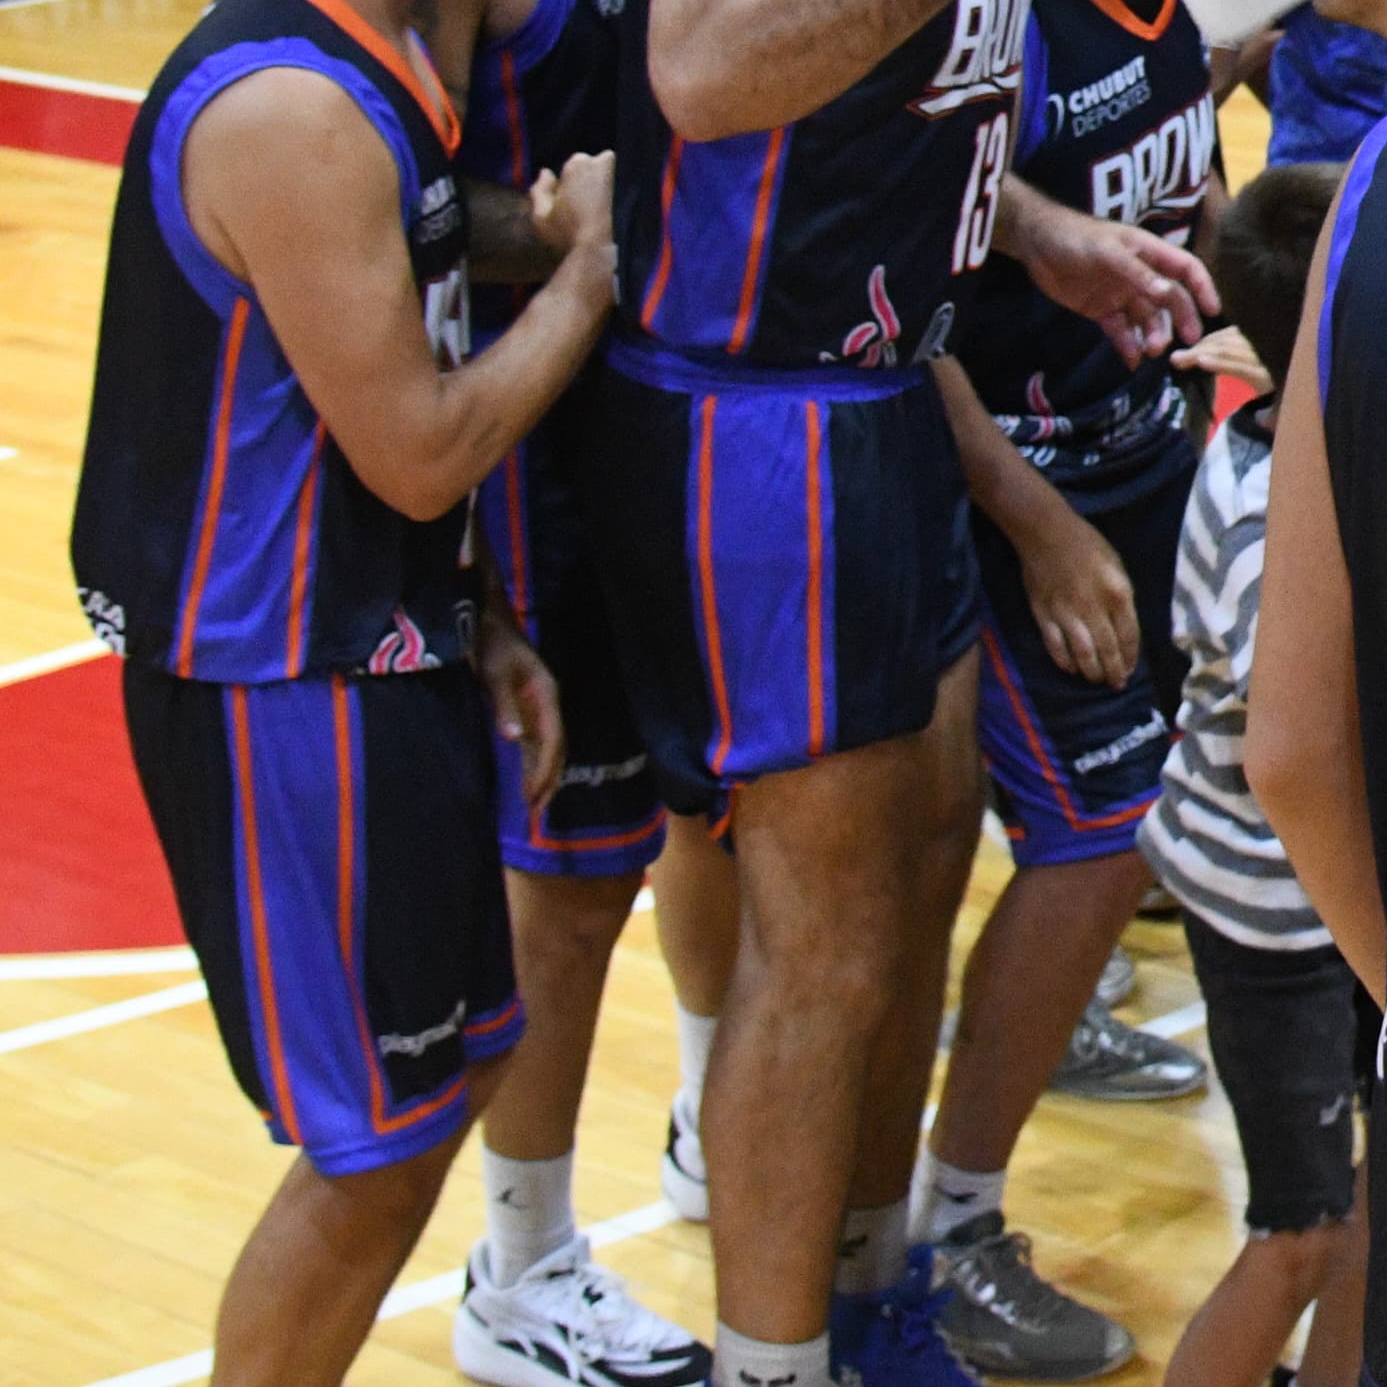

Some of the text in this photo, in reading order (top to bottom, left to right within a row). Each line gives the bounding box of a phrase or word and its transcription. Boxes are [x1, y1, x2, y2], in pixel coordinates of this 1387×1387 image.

[1068, 54, 1147, 114] CHUBUT
[1071, 78, 1152, 138] DEPORTES
[950, 111, 1008, 276] 13
[1089, 90, 1217, 226] BROW
